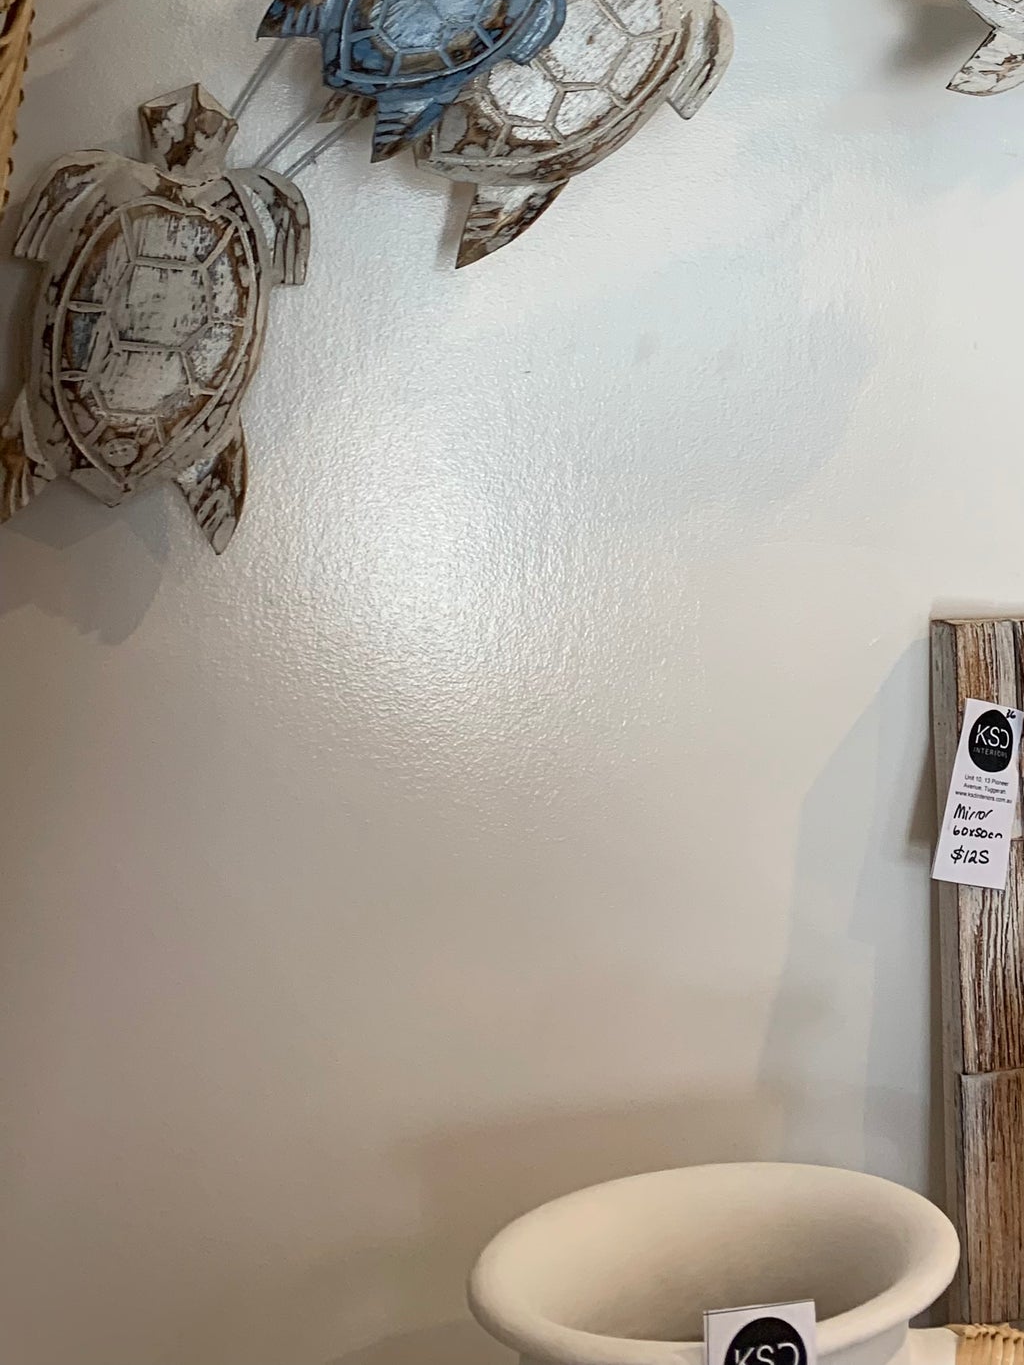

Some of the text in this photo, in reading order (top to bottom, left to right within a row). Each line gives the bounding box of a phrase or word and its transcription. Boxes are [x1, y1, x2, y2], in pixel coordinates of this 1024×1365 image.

[975, 724, 1010, 749] KSD
[973, 746, 1008, 759] INTERIORS
[991, 779, 1009, 787] Pioneer
[953, 803, 993, 821] Mirror
[950, 845, 990, 865] $125
